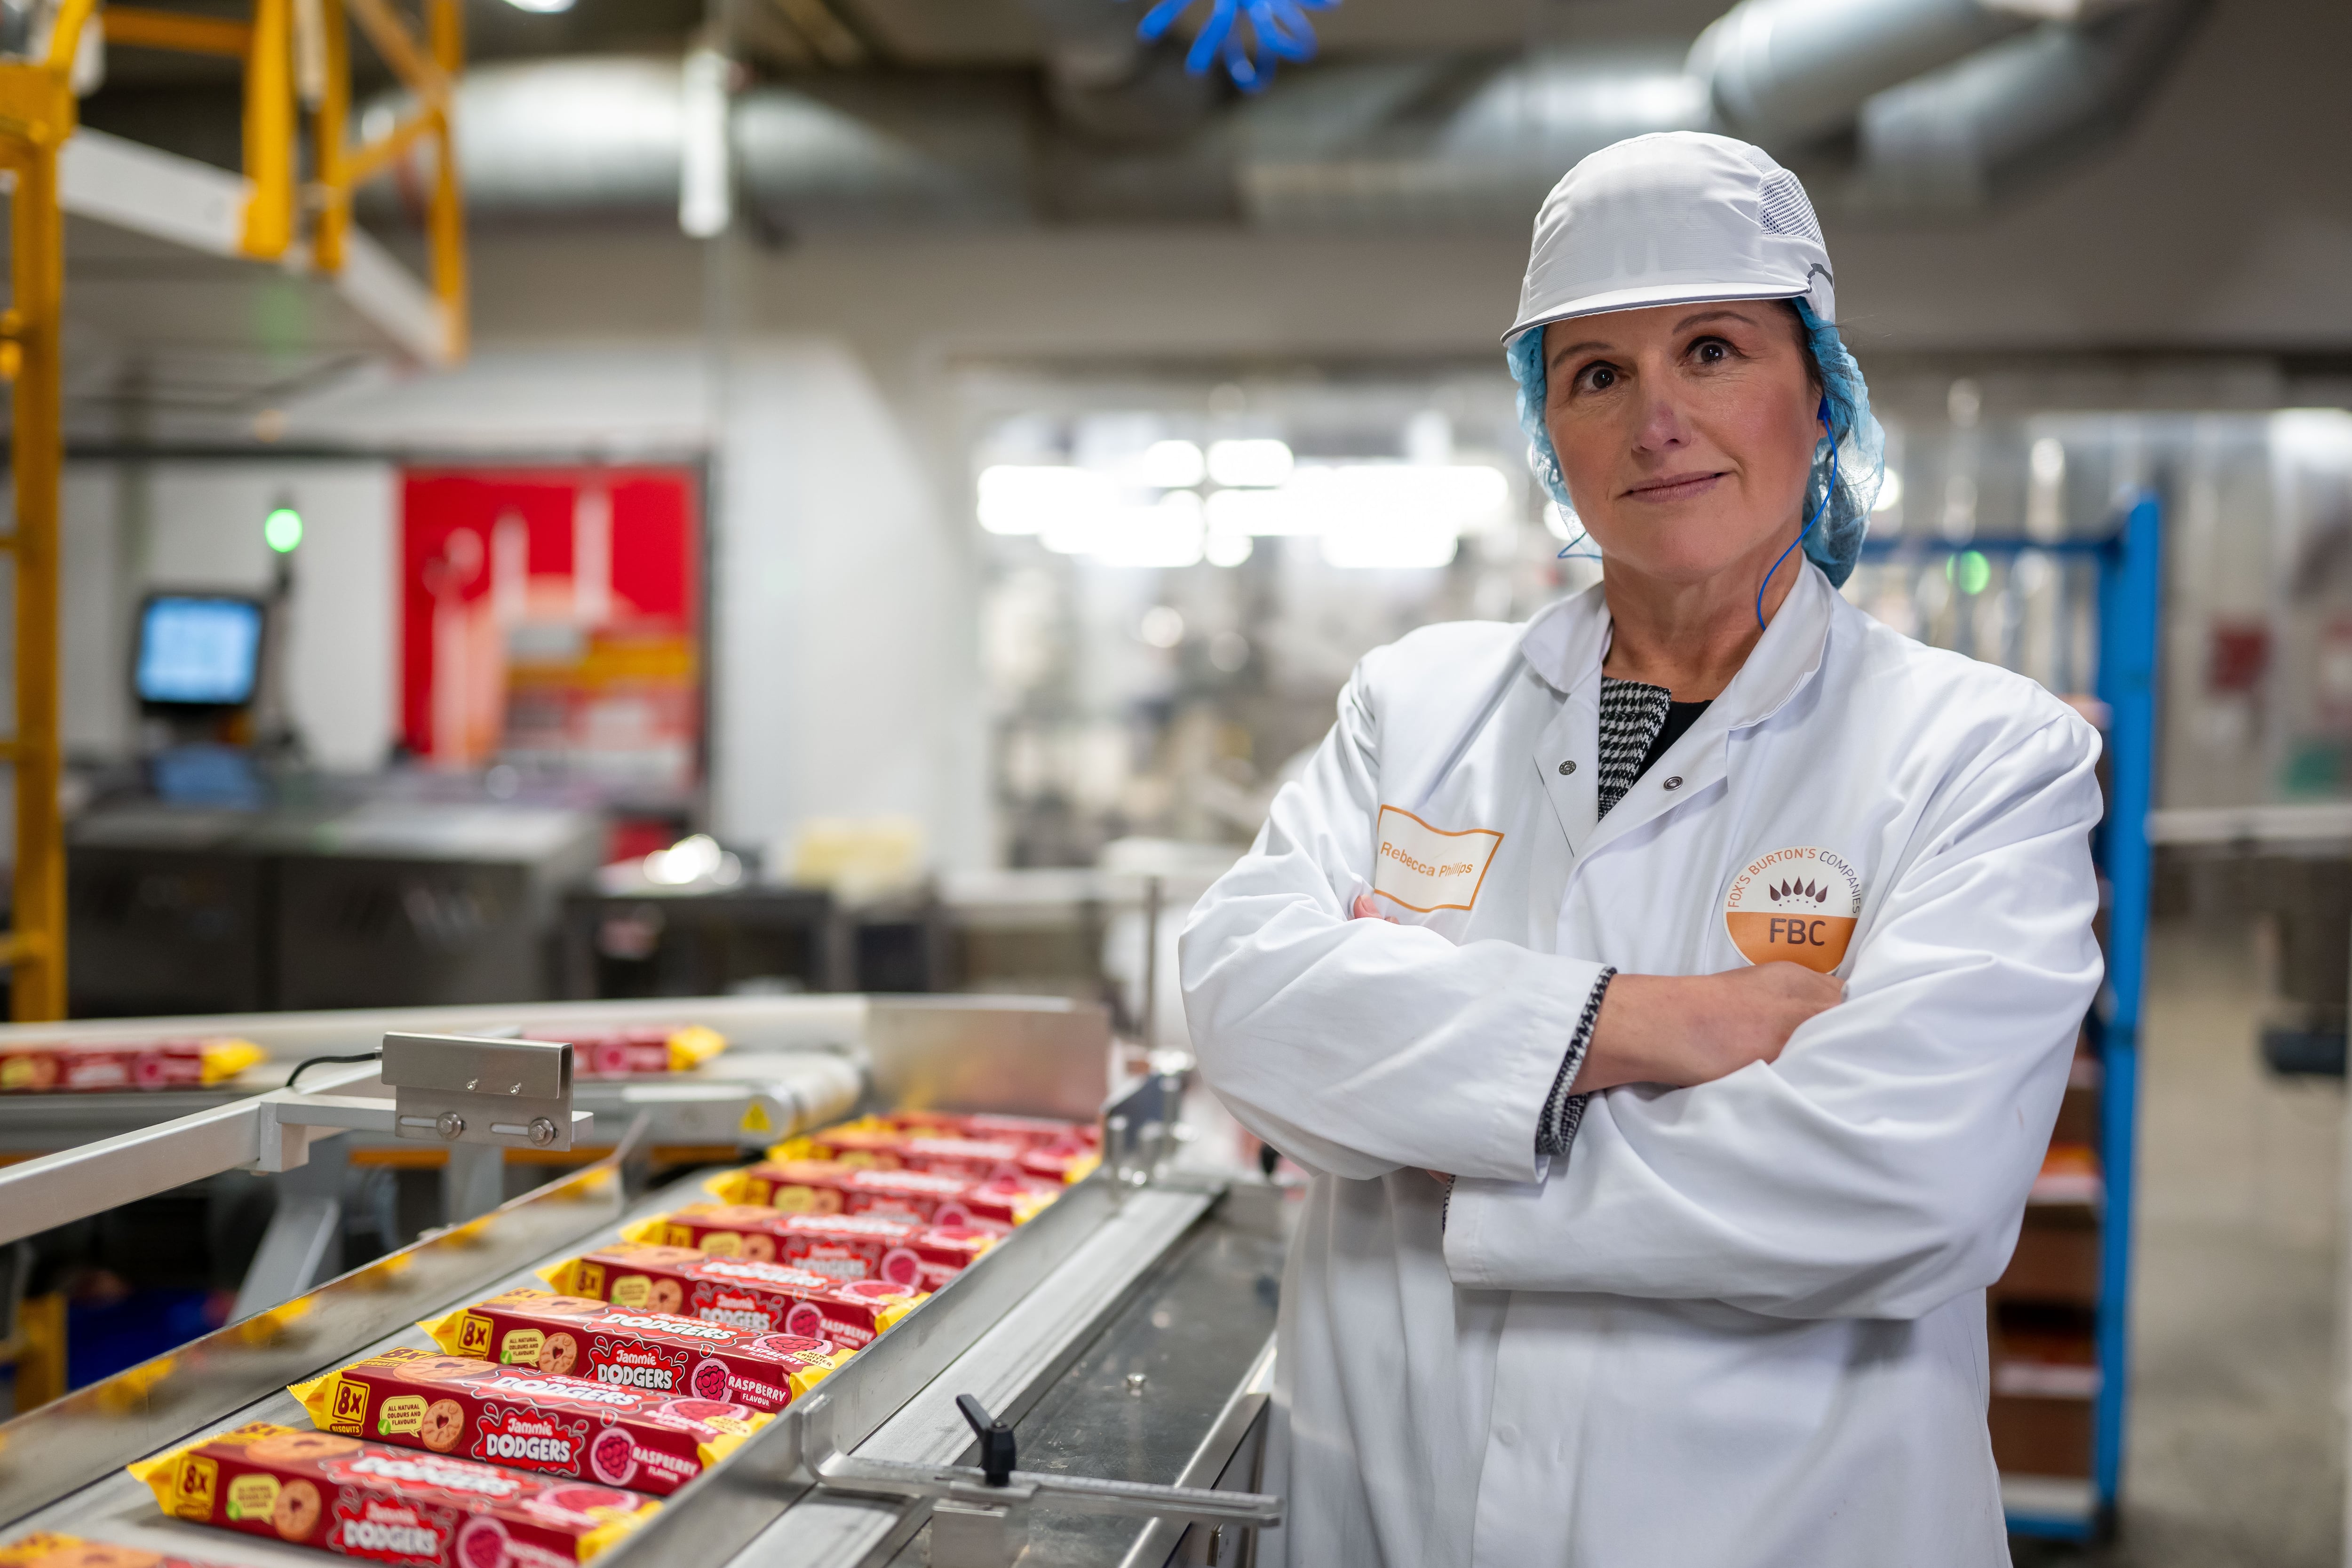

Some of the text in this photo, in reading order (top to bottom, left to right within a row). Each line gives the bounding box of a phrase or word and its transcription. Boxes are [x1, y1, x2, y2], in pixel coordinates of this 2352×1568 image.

[1380, 841, 1473, 877] Rebecca Phillips
[1727, 848, 1861, 914] FOX'S BURTON'S COMPANIES
[1769, 918, 1826, 947] FBC
[599, 1313, 739, 1340] DODGERS
[650, 1313, 721, 1328] Jammie
[463, 1321, 487, 1346] 8x
[380, 1349, 427, 1360] 8x
[616, 1349, 657, 1366] Jammie
[738, 1344, 805, 1365] RASPBERRY
[748, 1352, 779, 1361] FLAVOUR
[797, 1353, 833, 1367] FRUITIER
[545, 1376, 622, 1391] Jammie
[597, 1363, 673, 1390] DODGERS
[728, 1376, 787, 1402] RASPBERRY
[338, 1386, 362, 1415] 8x
[489, 1376, 643, 1406] DODGERS
[742, 1393, 770, 1407] FLAVOUR
[508, 1418, 553, 1436] Jammie
[486, 1433, 572, 1463] DODGERS
[632, 1447, 698, 1476] RASPBERRY
